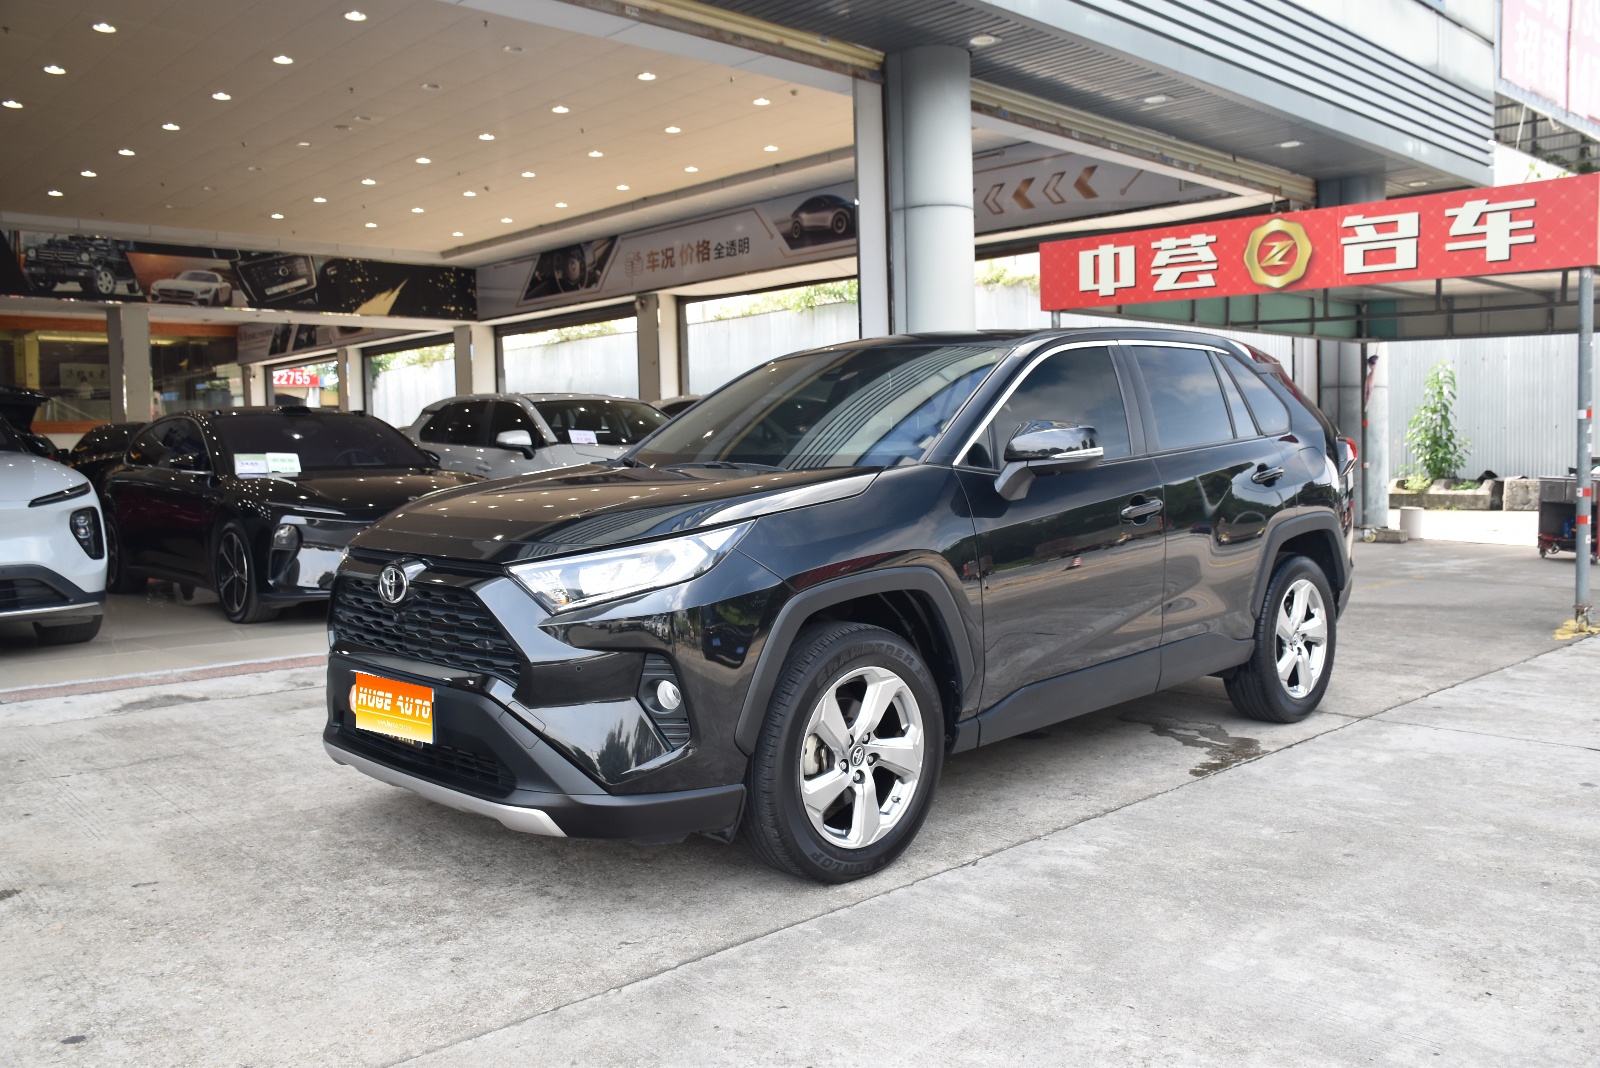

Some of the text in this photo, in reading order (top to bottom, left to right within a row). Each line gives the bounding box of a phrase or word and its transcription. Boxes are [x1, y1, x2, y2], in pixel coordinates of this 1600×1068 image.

[646, 237, 750, 273] 车况 价格 全透明
[1079, 234, 1218, 297] 中荟
[1340, 198, 1537, 275] 名车
